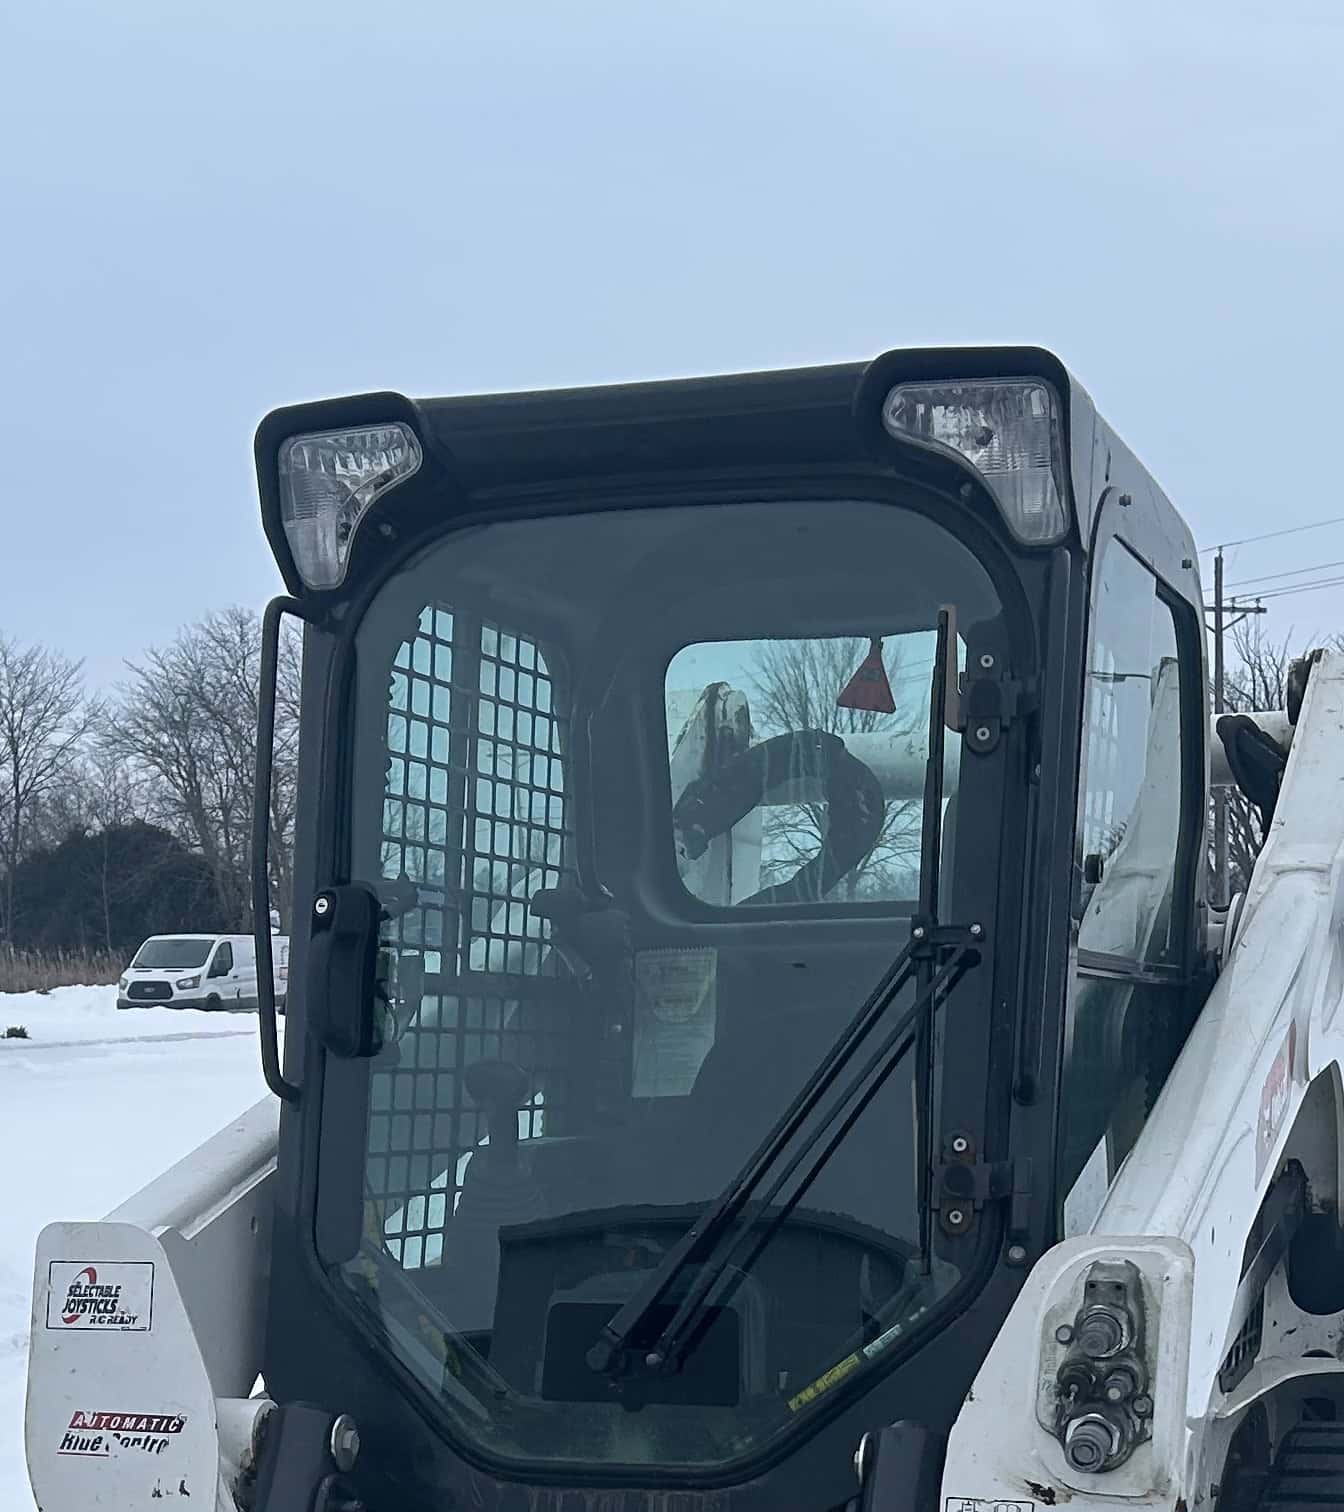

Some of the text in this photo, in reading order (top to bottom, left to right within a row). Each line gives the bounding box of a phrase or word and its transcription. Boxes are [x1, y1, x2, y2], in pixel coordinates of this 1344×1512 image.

[67, 1285, 122, 1298] SELECTABLE
[61, 1298, 119, 1314] JOYSTICKS
[72, 1412, 181, 1432] AUTOMATIC
